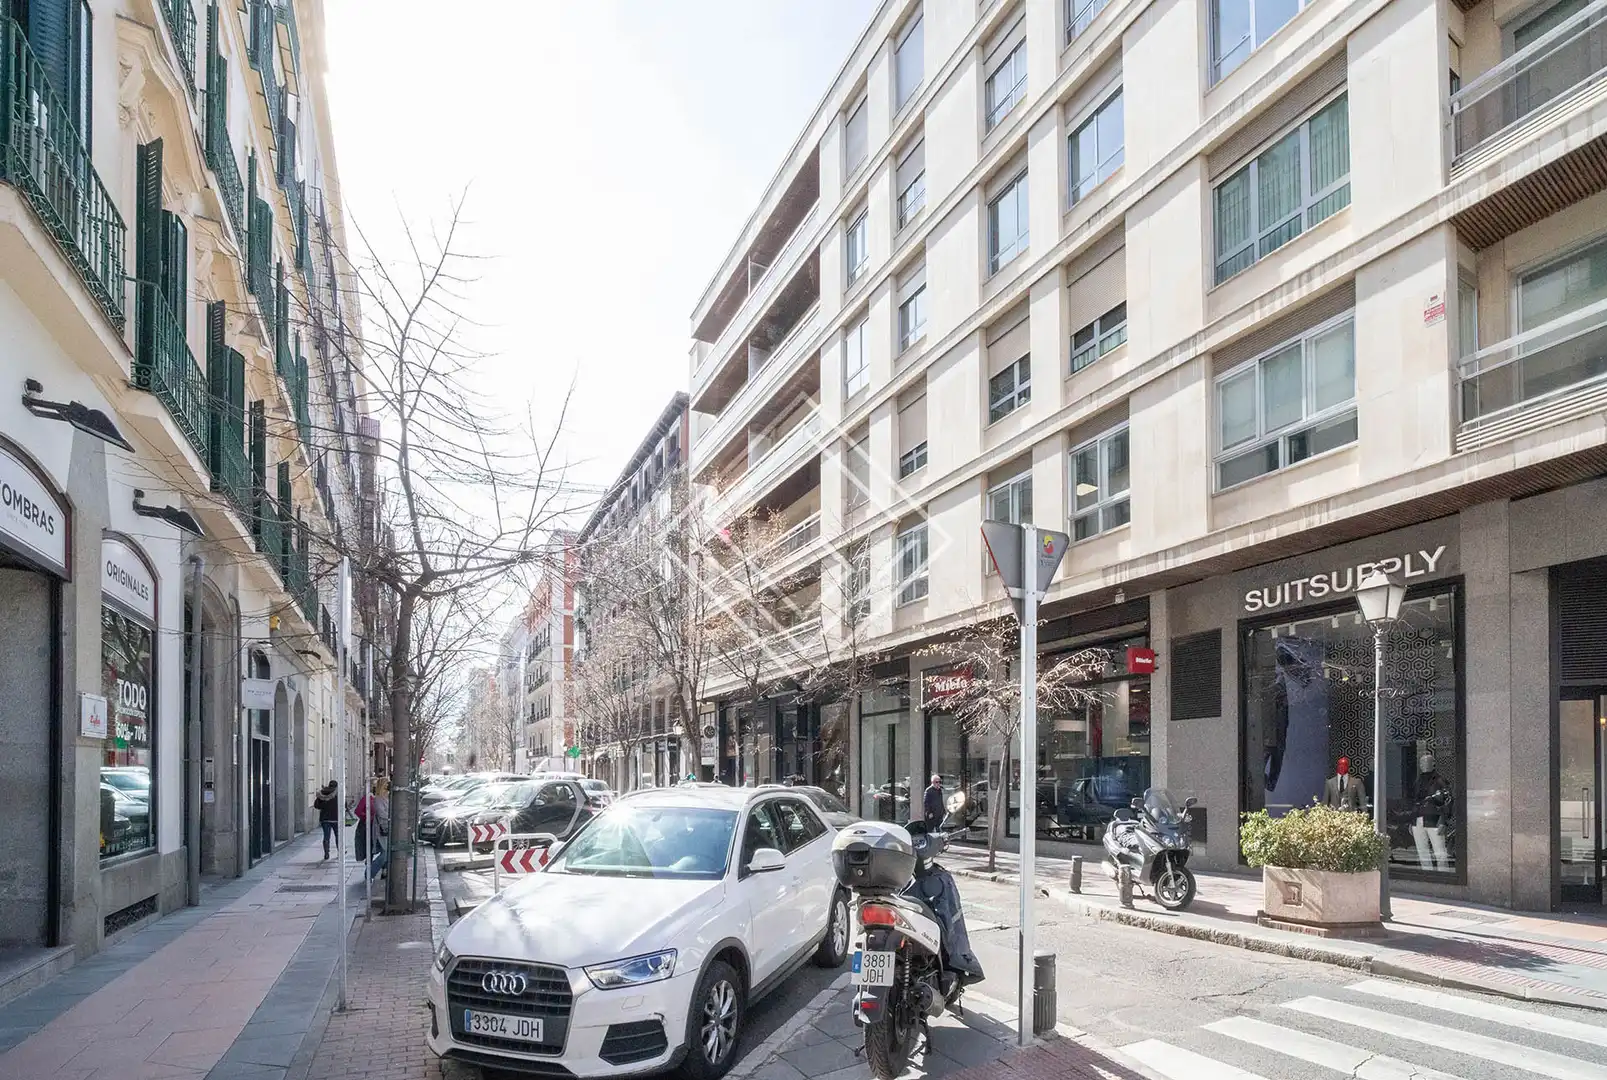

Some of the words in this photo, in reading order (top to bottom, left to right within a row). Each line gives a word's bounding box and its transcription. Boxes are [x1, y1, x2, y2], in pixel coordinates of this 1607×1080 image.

[0, 483, 55, 536] OMBRAS
[106, 560, 149, 601] ORIGINALES
[1244, 545, 1446, 612] SUITSUPPLY
[117, 678, 147, 710] TODO
[862, 968, 884, 983] JDH
[863, 954, 891, 968] 3881
[473, 1014, 507, 1034] 3304
[512, 1019, 540, 1039] JDH
